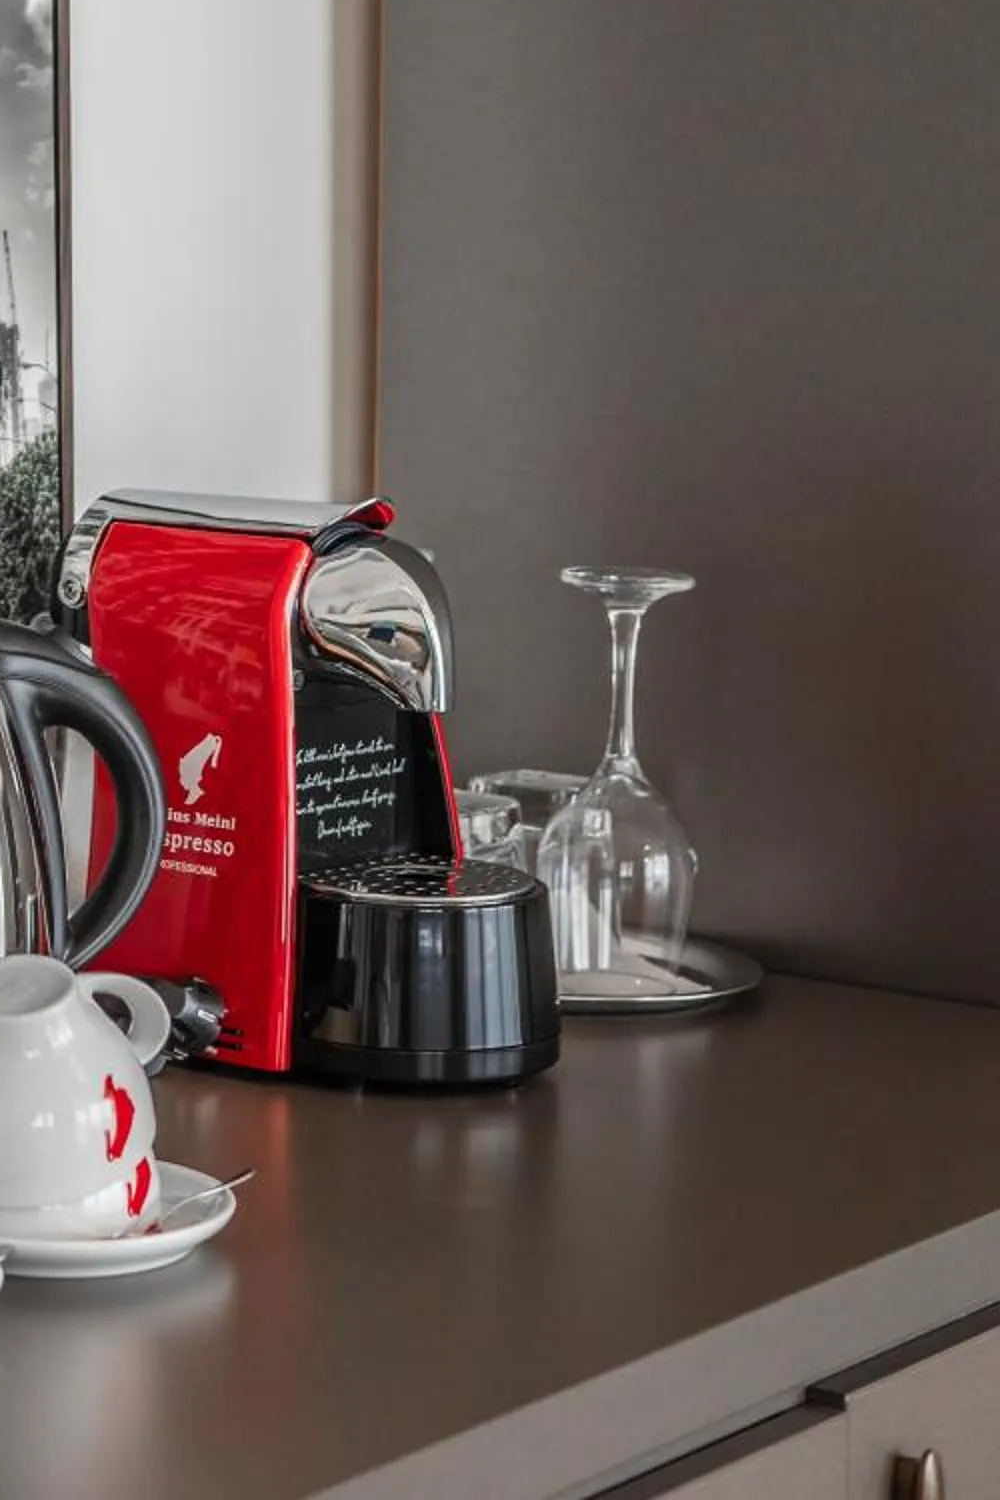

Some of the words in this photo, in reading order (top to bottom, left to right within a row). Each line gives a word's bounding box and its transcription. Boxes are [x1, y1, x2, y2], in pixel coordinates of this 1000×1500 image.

[167, 807, 192, 823] ius
[193, 811, 237, 831] Meinl
[162, 832, 236, 857] spresso
